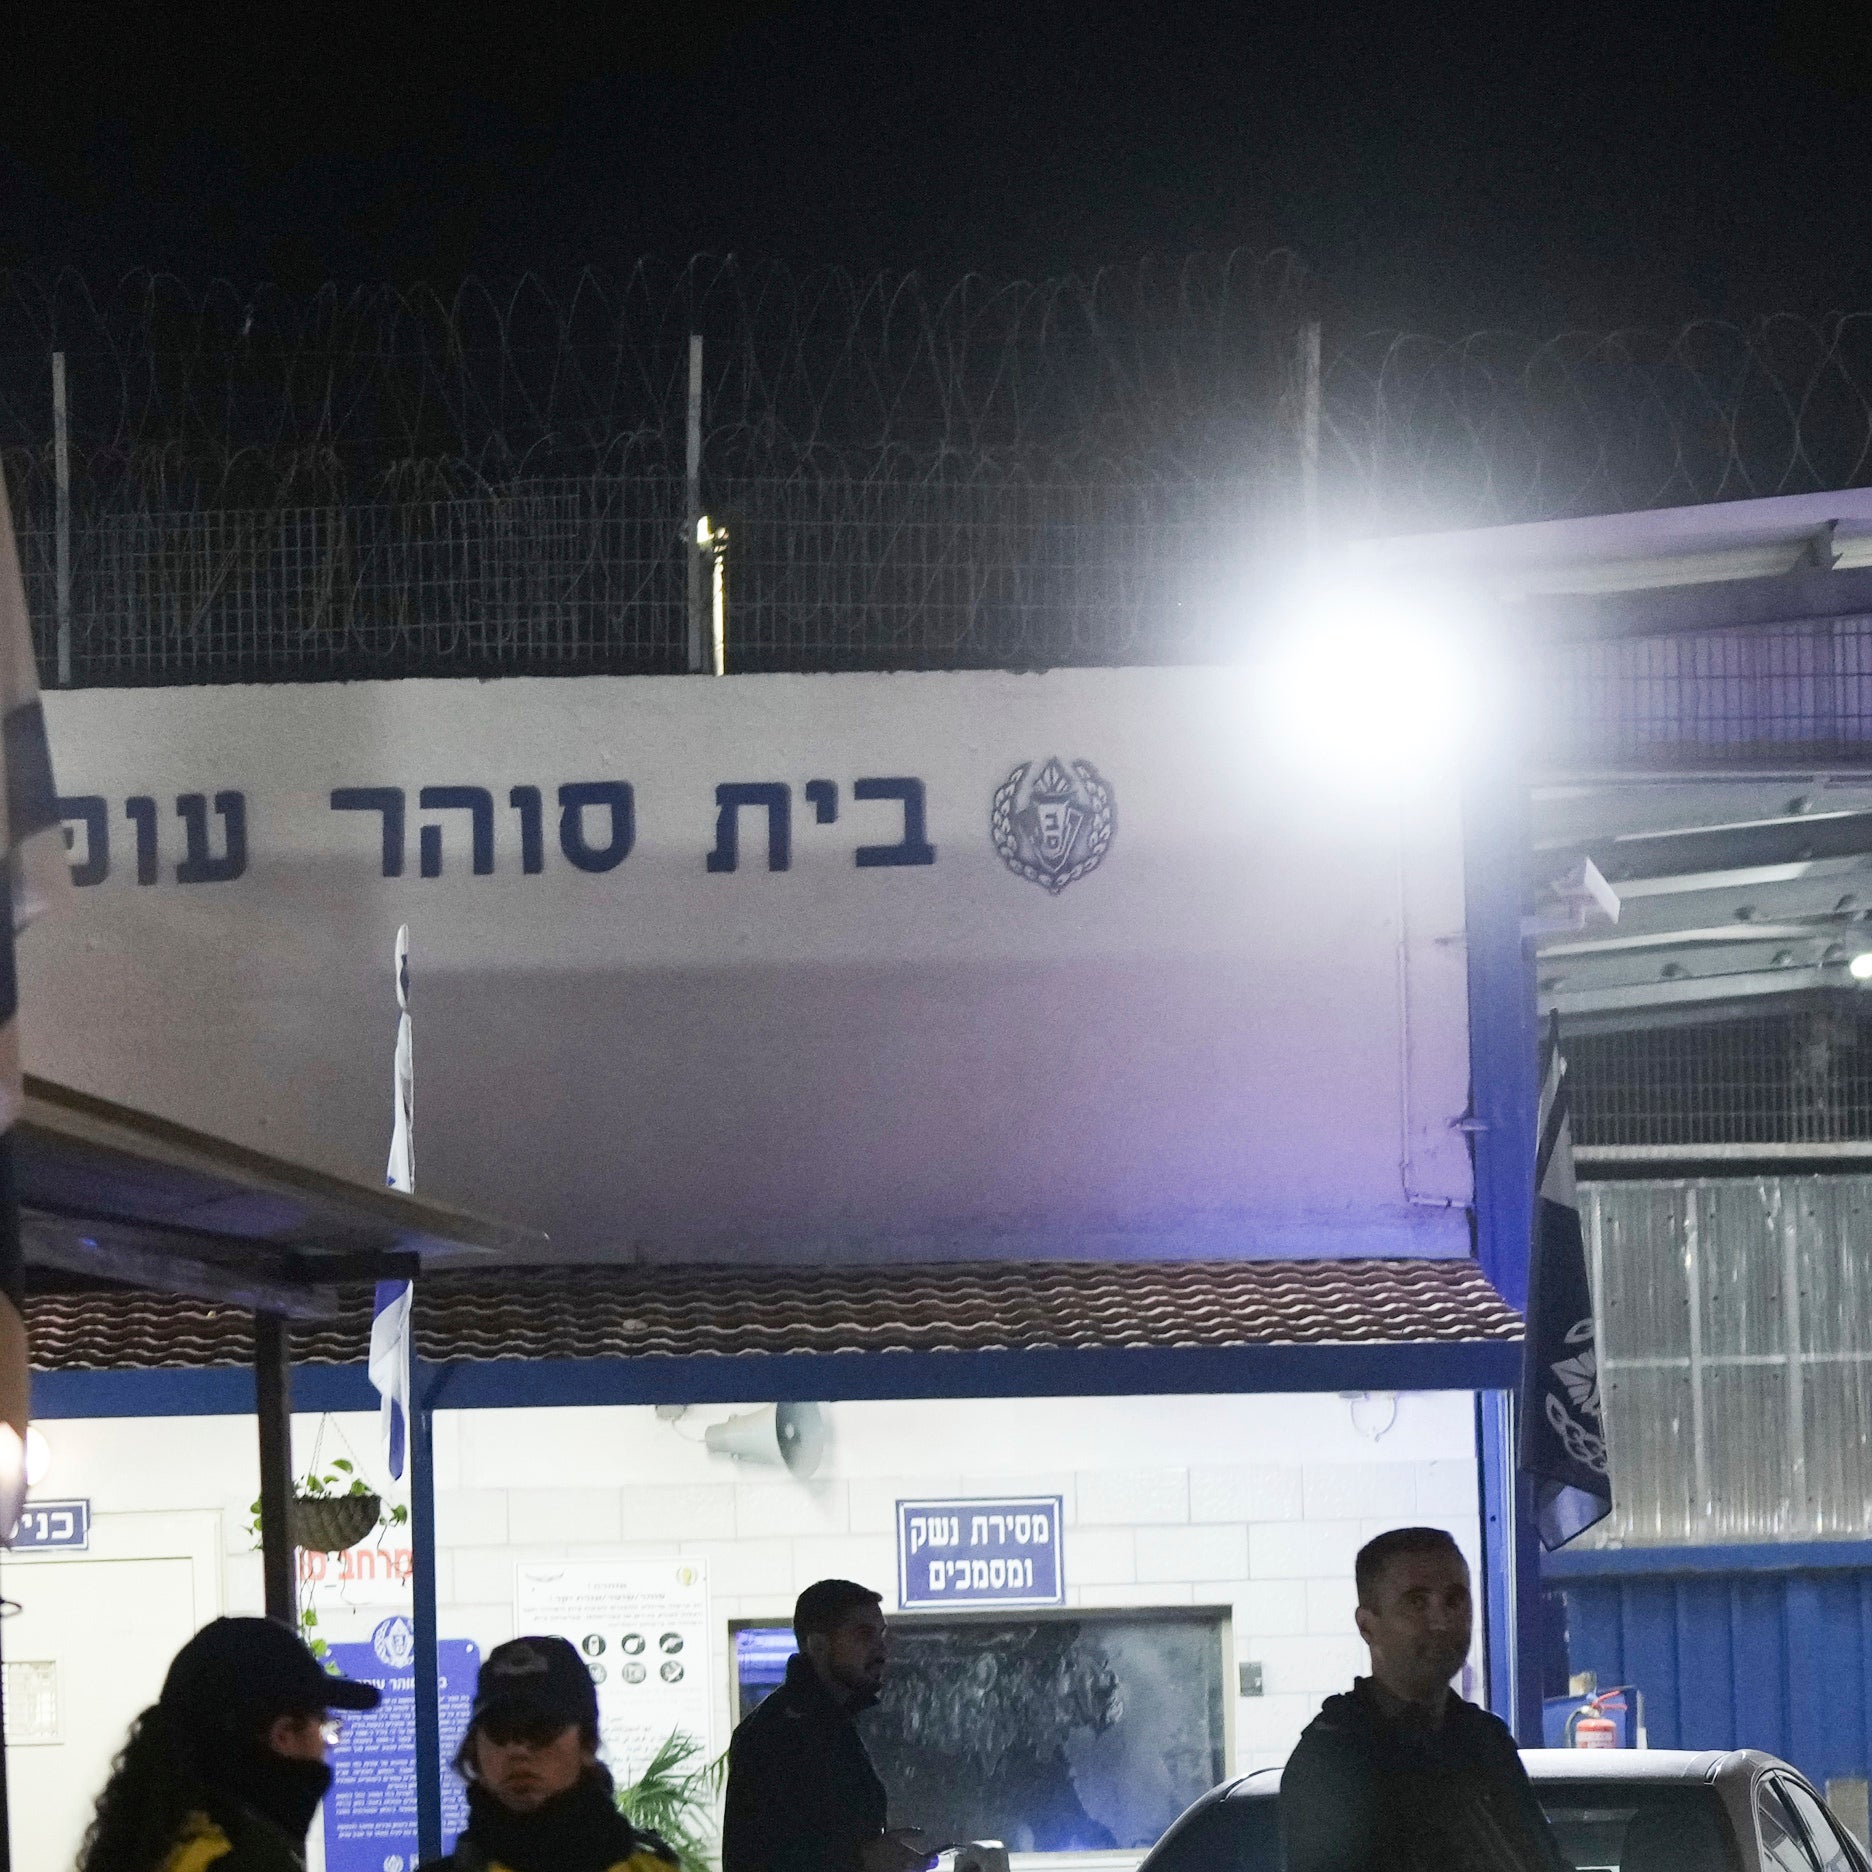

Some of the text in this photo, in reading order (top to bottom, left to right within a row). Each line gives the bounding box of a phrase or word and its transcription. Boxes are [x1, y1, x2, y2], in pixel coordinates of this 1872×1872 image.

[329, 779, 638, 880] סוהר
[705, 776, 937, 875] בית
[909, 1513, 1050, 1555] מסירת נשק
[928, 1557, 1033, 1592] ומסמכים
